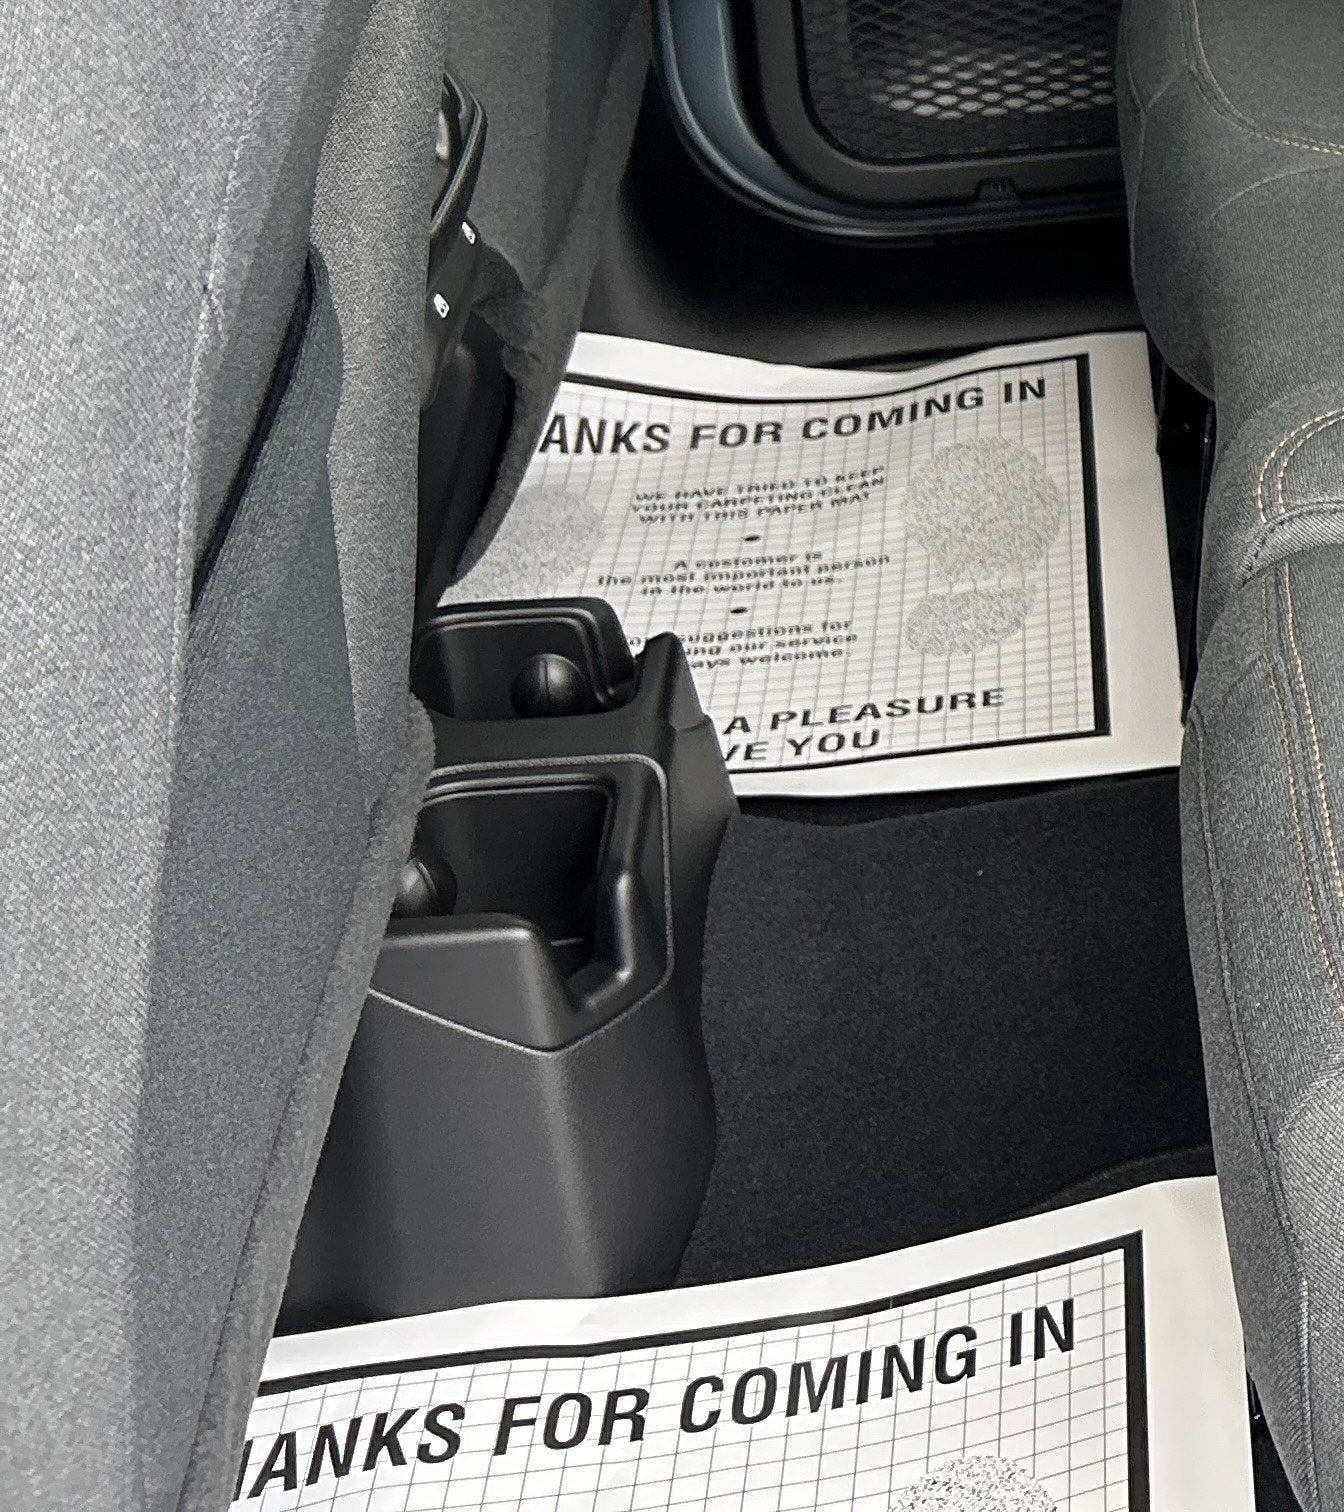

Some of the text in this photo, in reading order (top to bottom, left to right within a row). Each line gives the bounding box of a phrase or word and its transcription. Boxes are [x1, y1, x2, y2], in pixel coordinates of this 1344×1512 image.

[539, 377, 1047, 454] ANKS FOR COMING IN
[673, 560, 688, 570] A
[722, 687, 1006, 735] A PLEASURE
[786, 729, 881, 757] YOU
[233, 1298, 1076, 1501] ANKS FOR COMING IN
